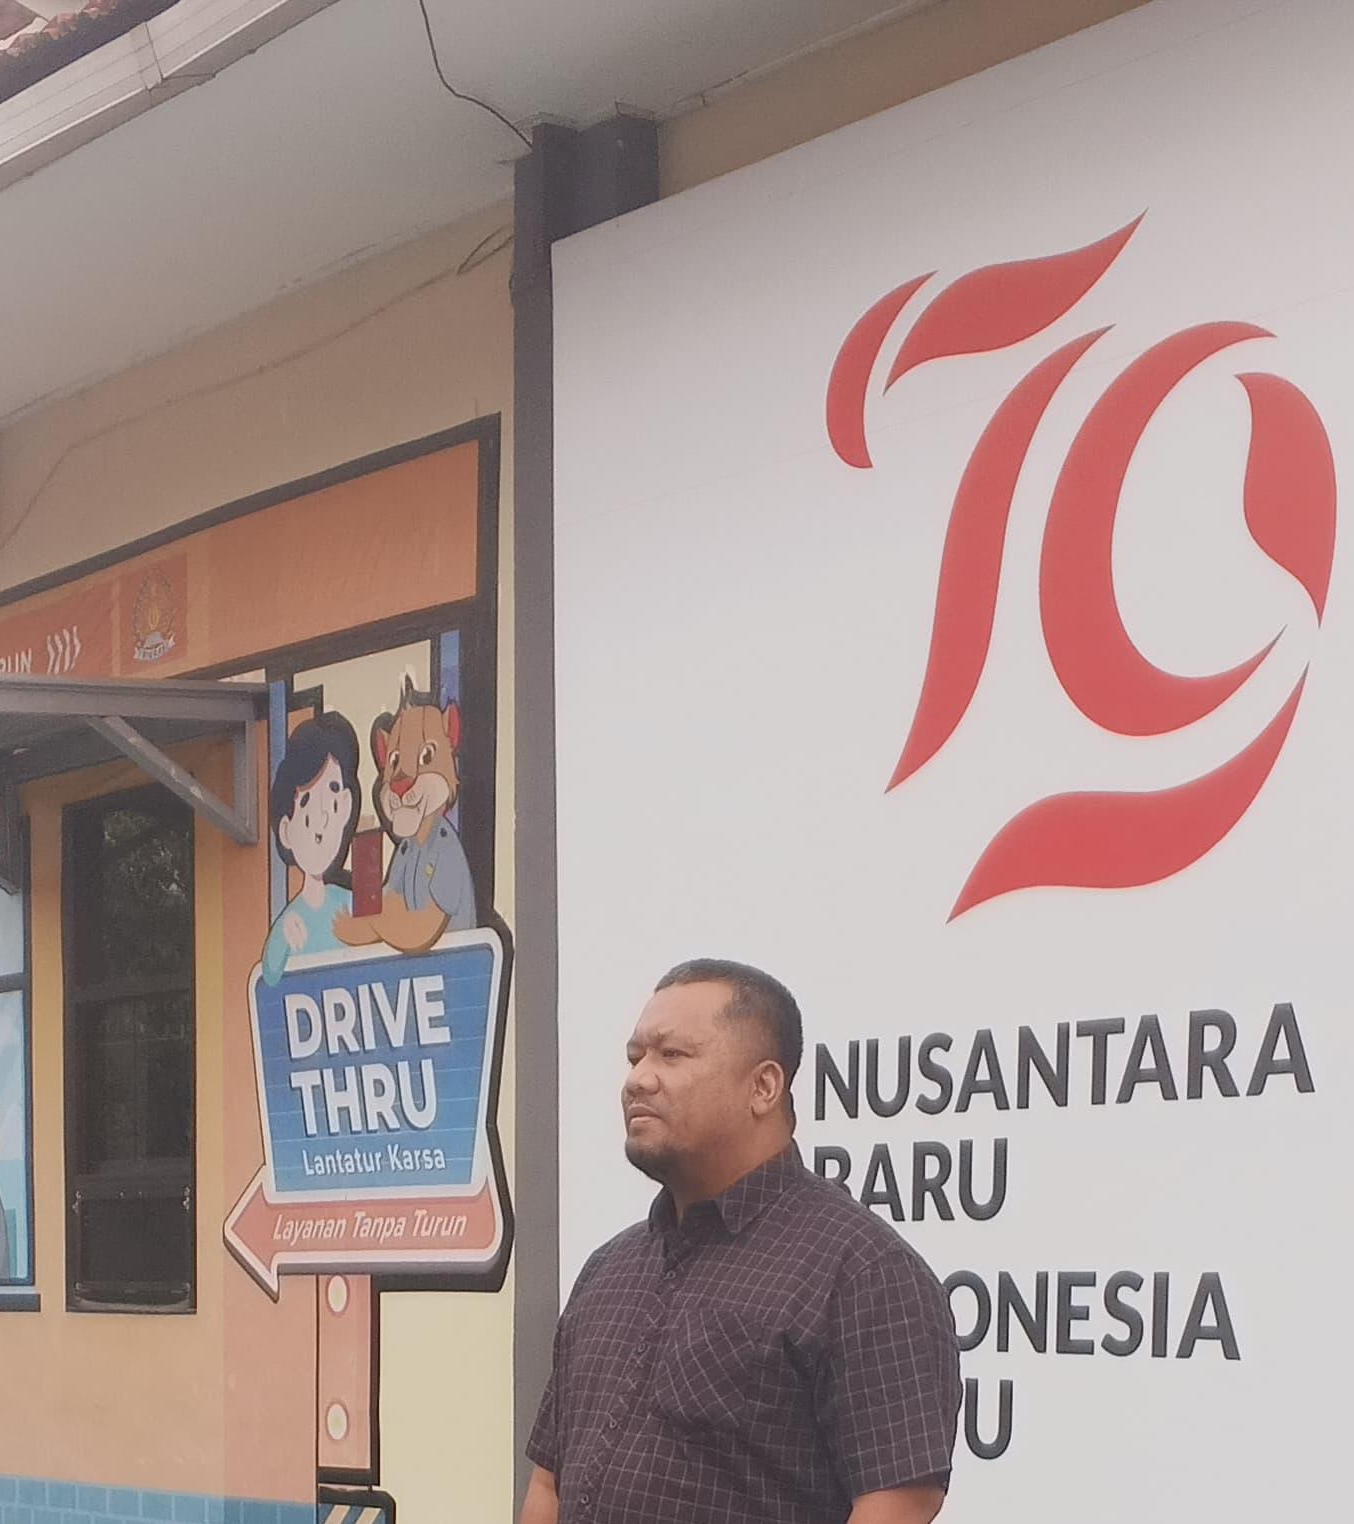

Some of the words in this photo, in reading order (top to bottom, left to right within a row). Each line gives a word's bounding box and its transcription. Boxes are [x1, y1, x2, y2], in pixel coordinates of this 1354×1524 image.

[284, 975, 452, 1060] DRIVE
[290, 1059, 438, 1138] THRU
[813, 1001, 1316, 1121] NUSANTARA
[301, 1147, 383, 1177] Lantatur
[386, 1143, 446, 1172] Karsa
[272, 1214, 347, 1246] Layanan
[351, 1210, 406, 1244] Tanpa
[412, 1208, 467, 1239] Turun
